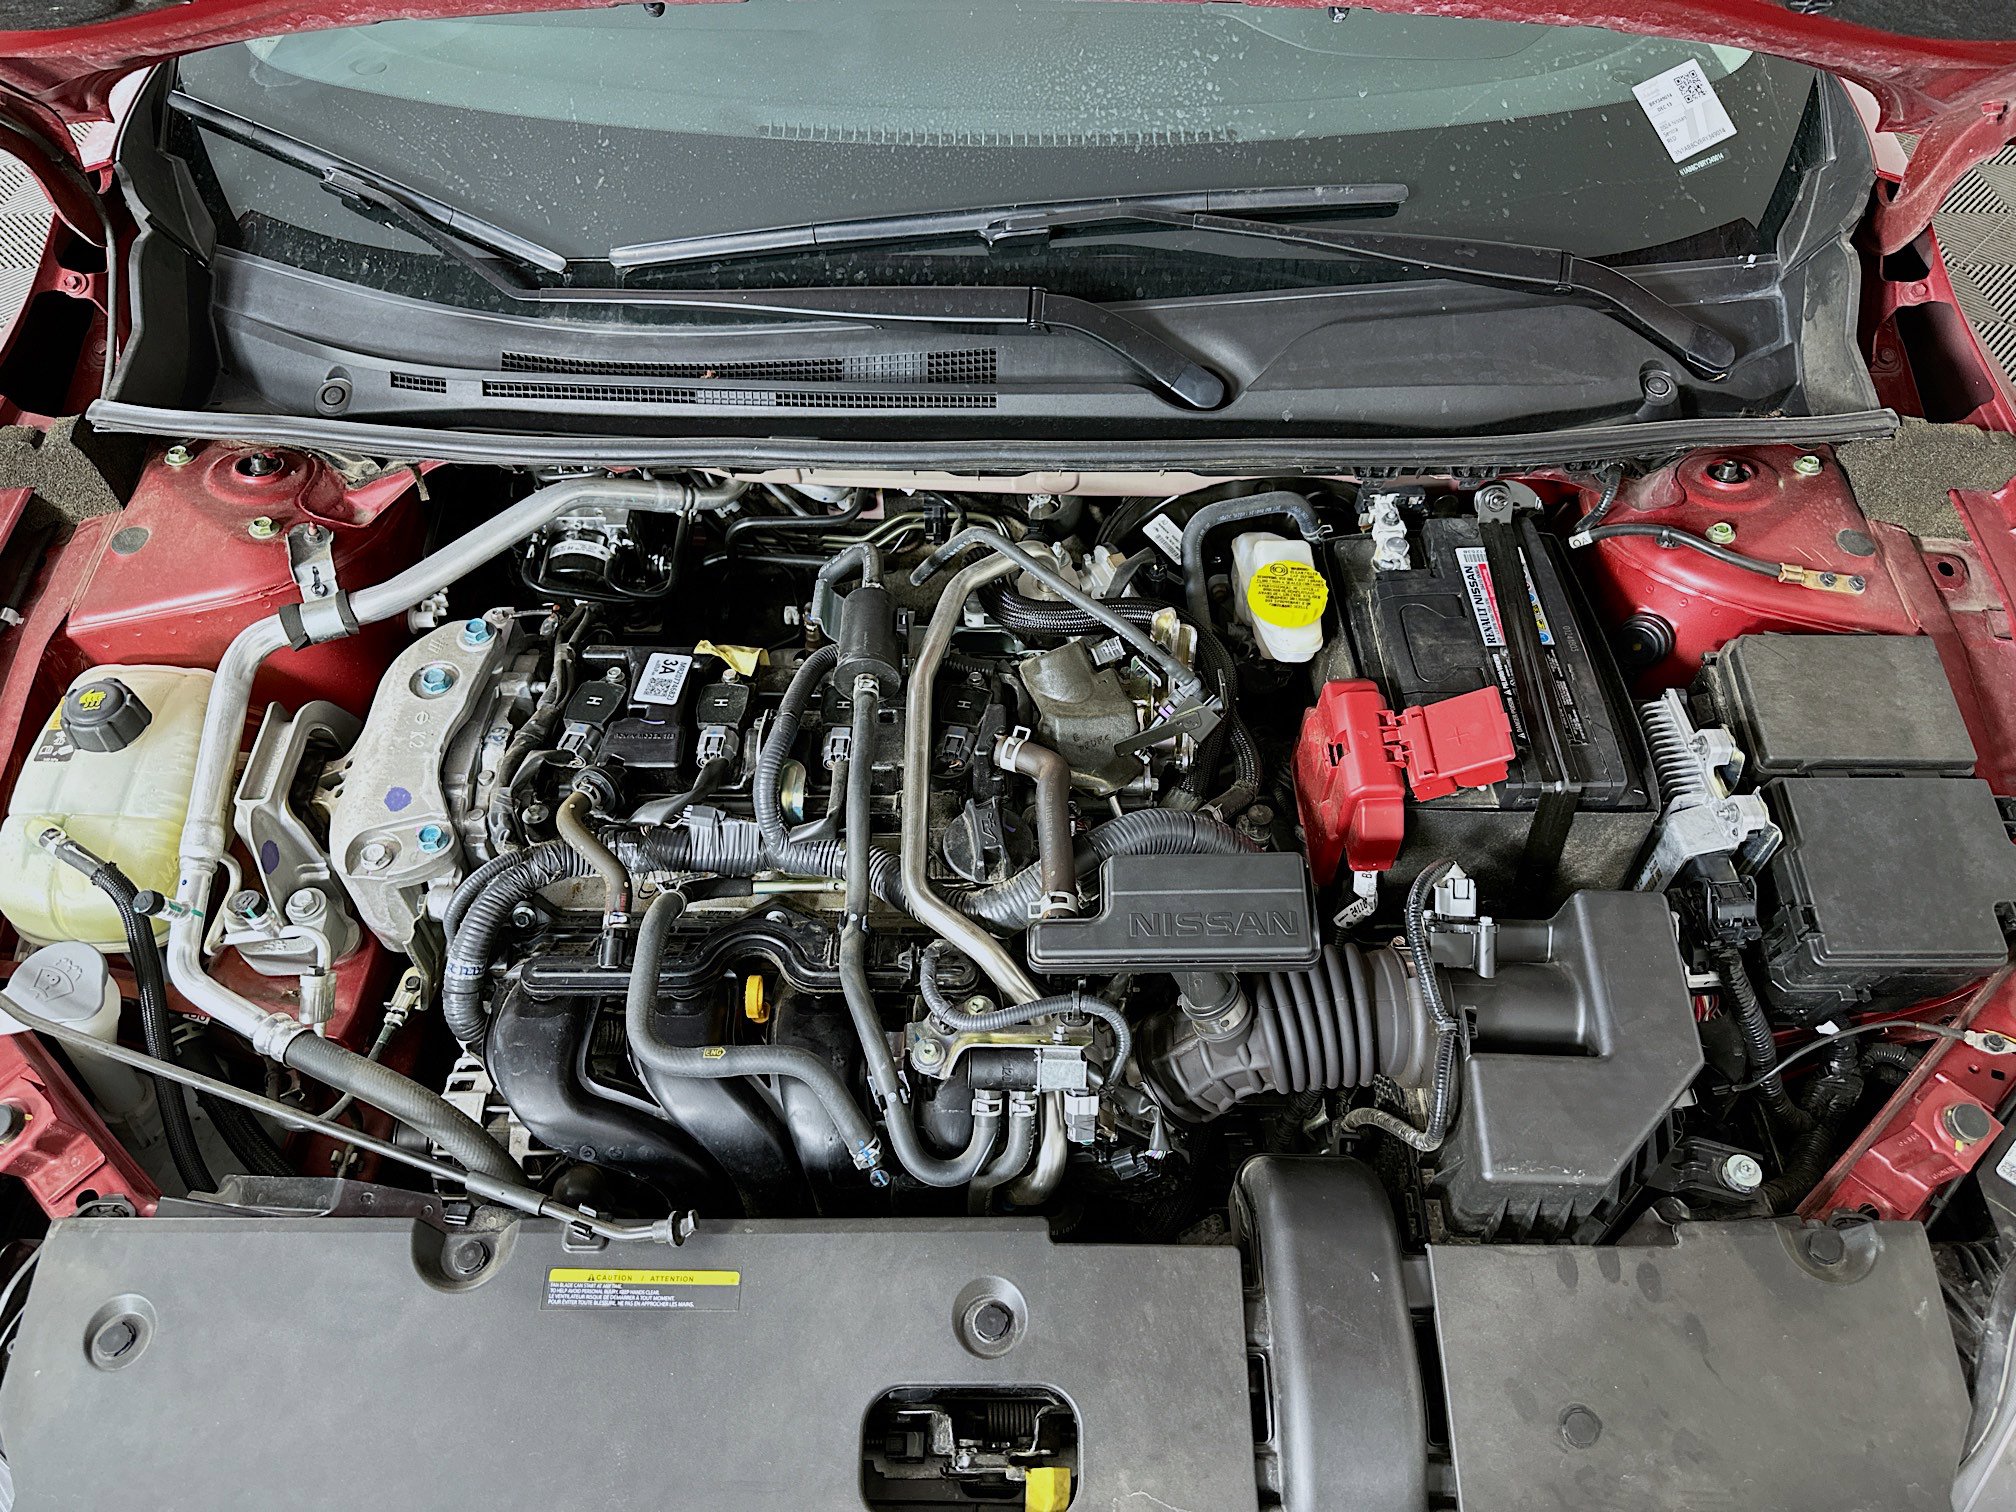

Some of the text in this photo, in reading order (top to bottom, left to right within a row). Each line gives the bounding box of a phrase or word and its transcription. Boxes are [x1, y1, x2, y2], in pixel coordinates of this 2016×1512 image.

[1464, 566, 1484, 605] NISSAN
[1477, 608, 1497, 644] RENAULT
[658, 658, 680, 675] 3A
[586, 696, 602, 706] H
[714, 698, 728, 706] H
[957, 700, 972, 708] H
[1128, 911, 1298, 938] NISSAN
